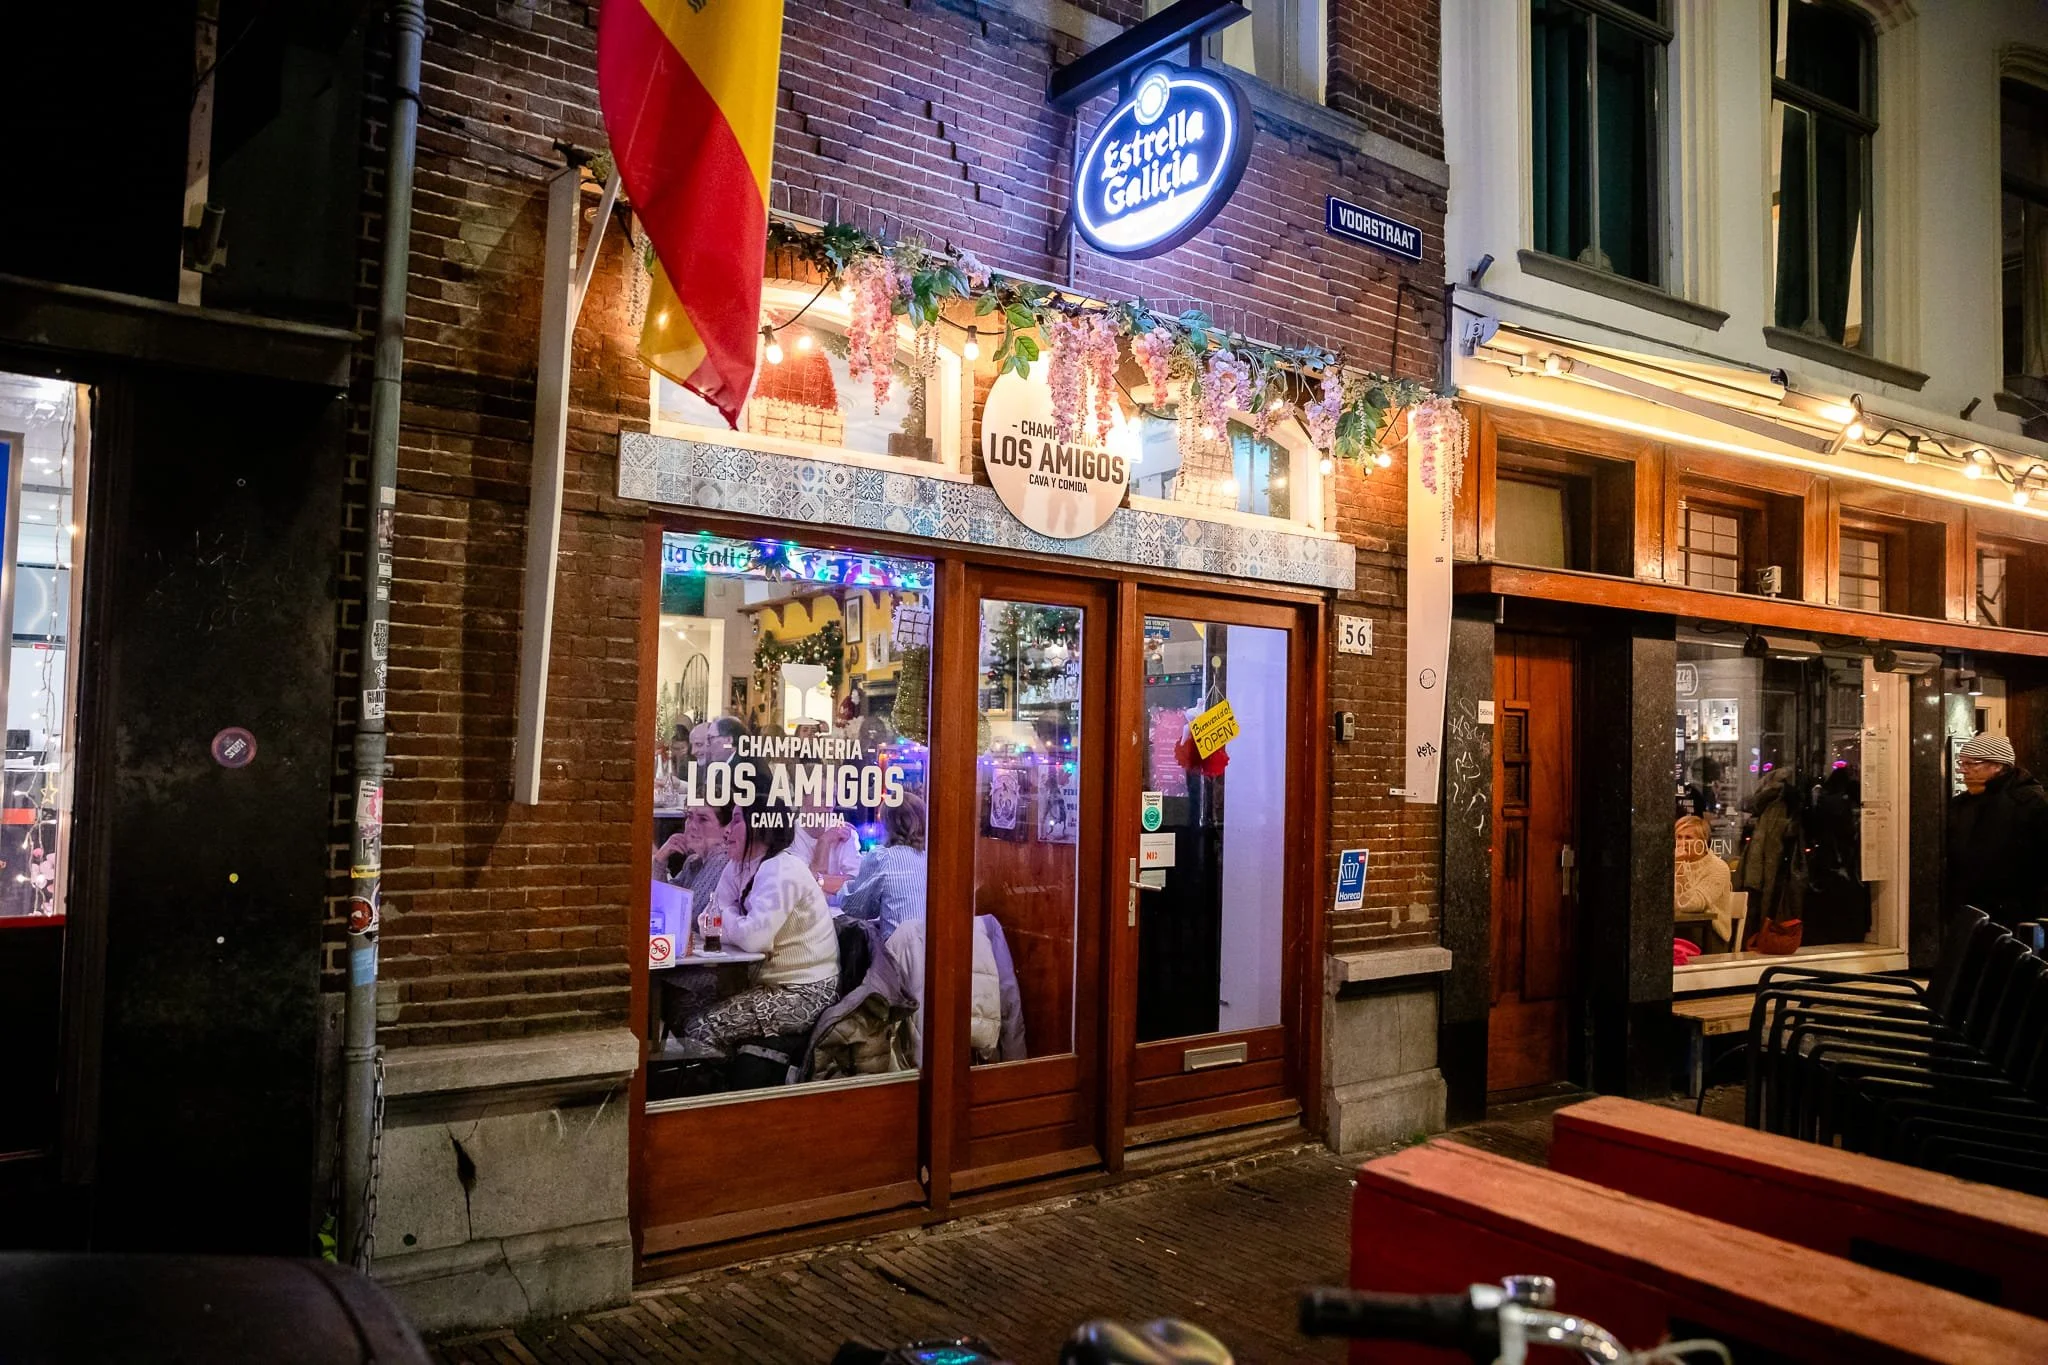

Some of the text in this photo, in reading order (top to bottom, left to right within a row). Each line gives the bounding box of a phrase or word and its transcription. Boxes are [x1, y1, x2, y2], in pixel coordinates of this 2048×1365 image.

[1102, 109, 1205, 181] Estrella
[1103, 150, 1199, 215] Galicia
[1338, 206, 1415, 251] VOORSTRAAT
[1021, 420, 1098, 449] CHAMPERIA
[990, 432, 1124, 485] LOS AMIGOS
[1029, 474, 1088, 494] CAVA Y COMIDA
[1345, 624, 1366, 647] 56
[738, 732, 863, 760] CHAMPAÑERIA
[1204, 722, 1234, 751] OPEN
[687, 761, 905, 808] LOS AMIGOS
[751, 812, 846, 828] CAVA Y COMIDA
[1339, 892, 1361, 901] Horeca
